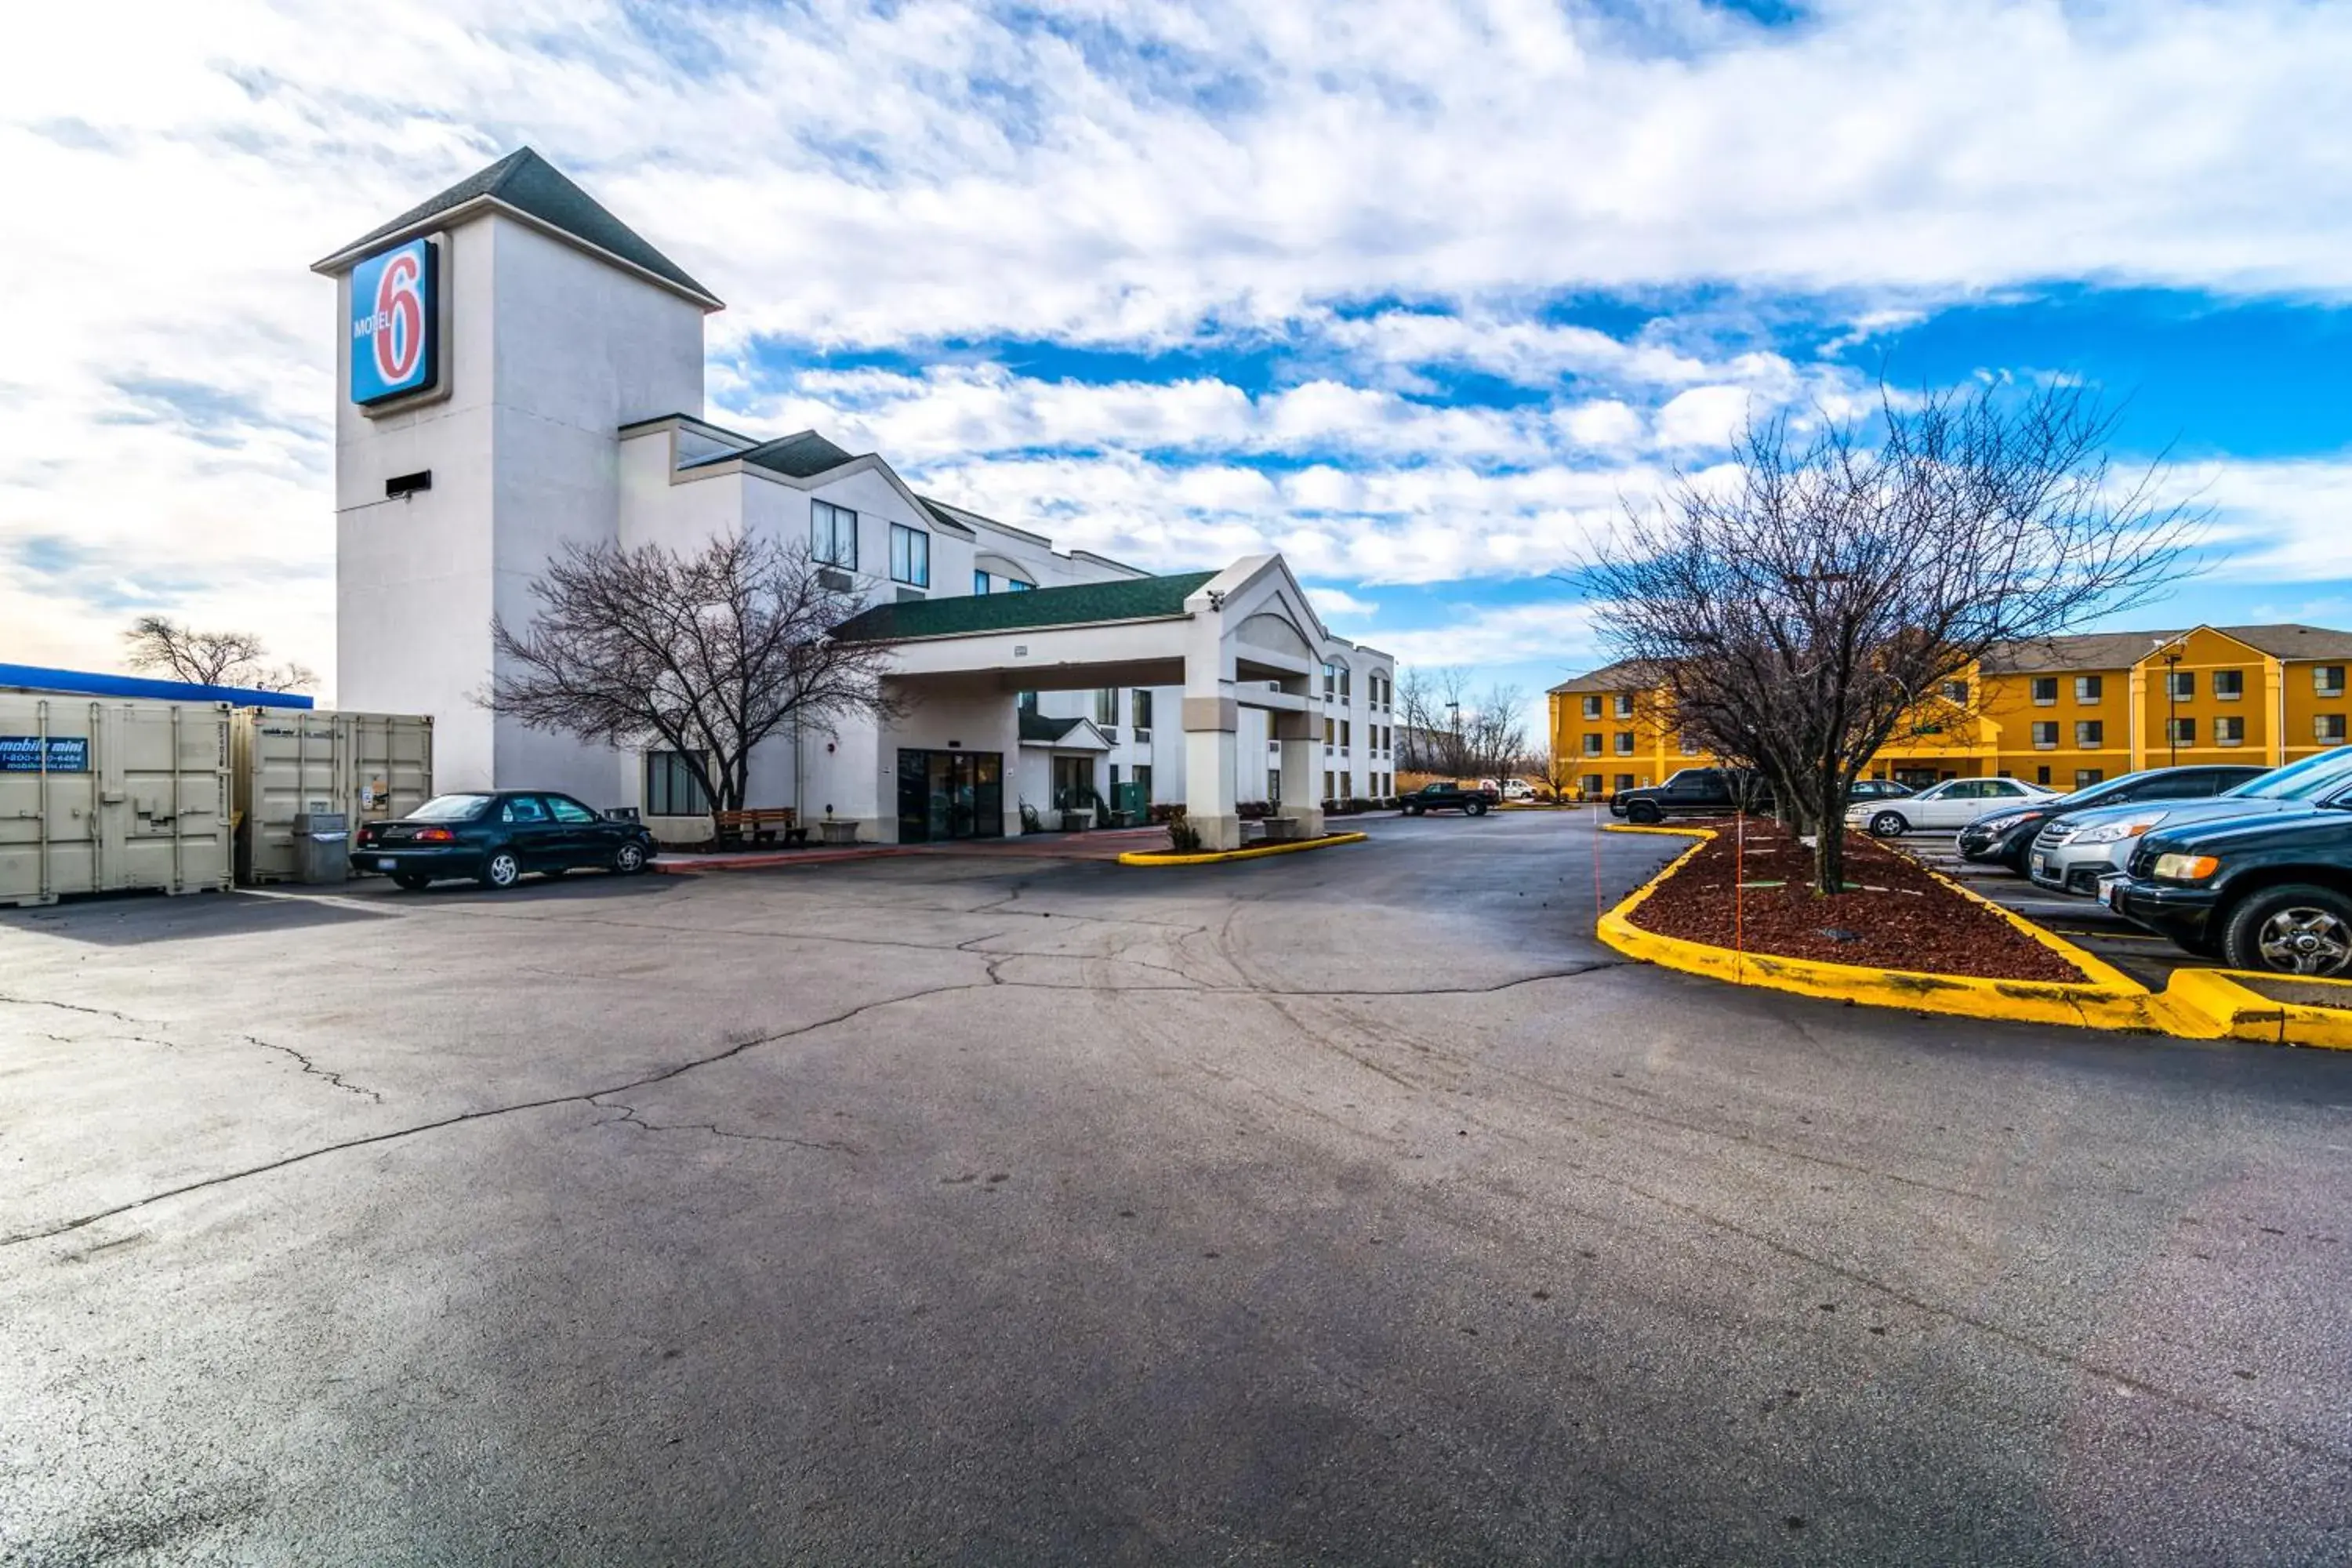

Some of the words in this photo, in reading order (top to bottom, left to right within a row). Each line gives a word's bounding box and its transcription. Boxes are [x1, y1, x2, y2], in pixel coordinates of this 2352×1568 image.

[354, 310, 391, 339] MOTEL
[374, 253, 422, 384] 6
[0, 739, 49, 752] mobil
[51, 740, 84, 752] mini
